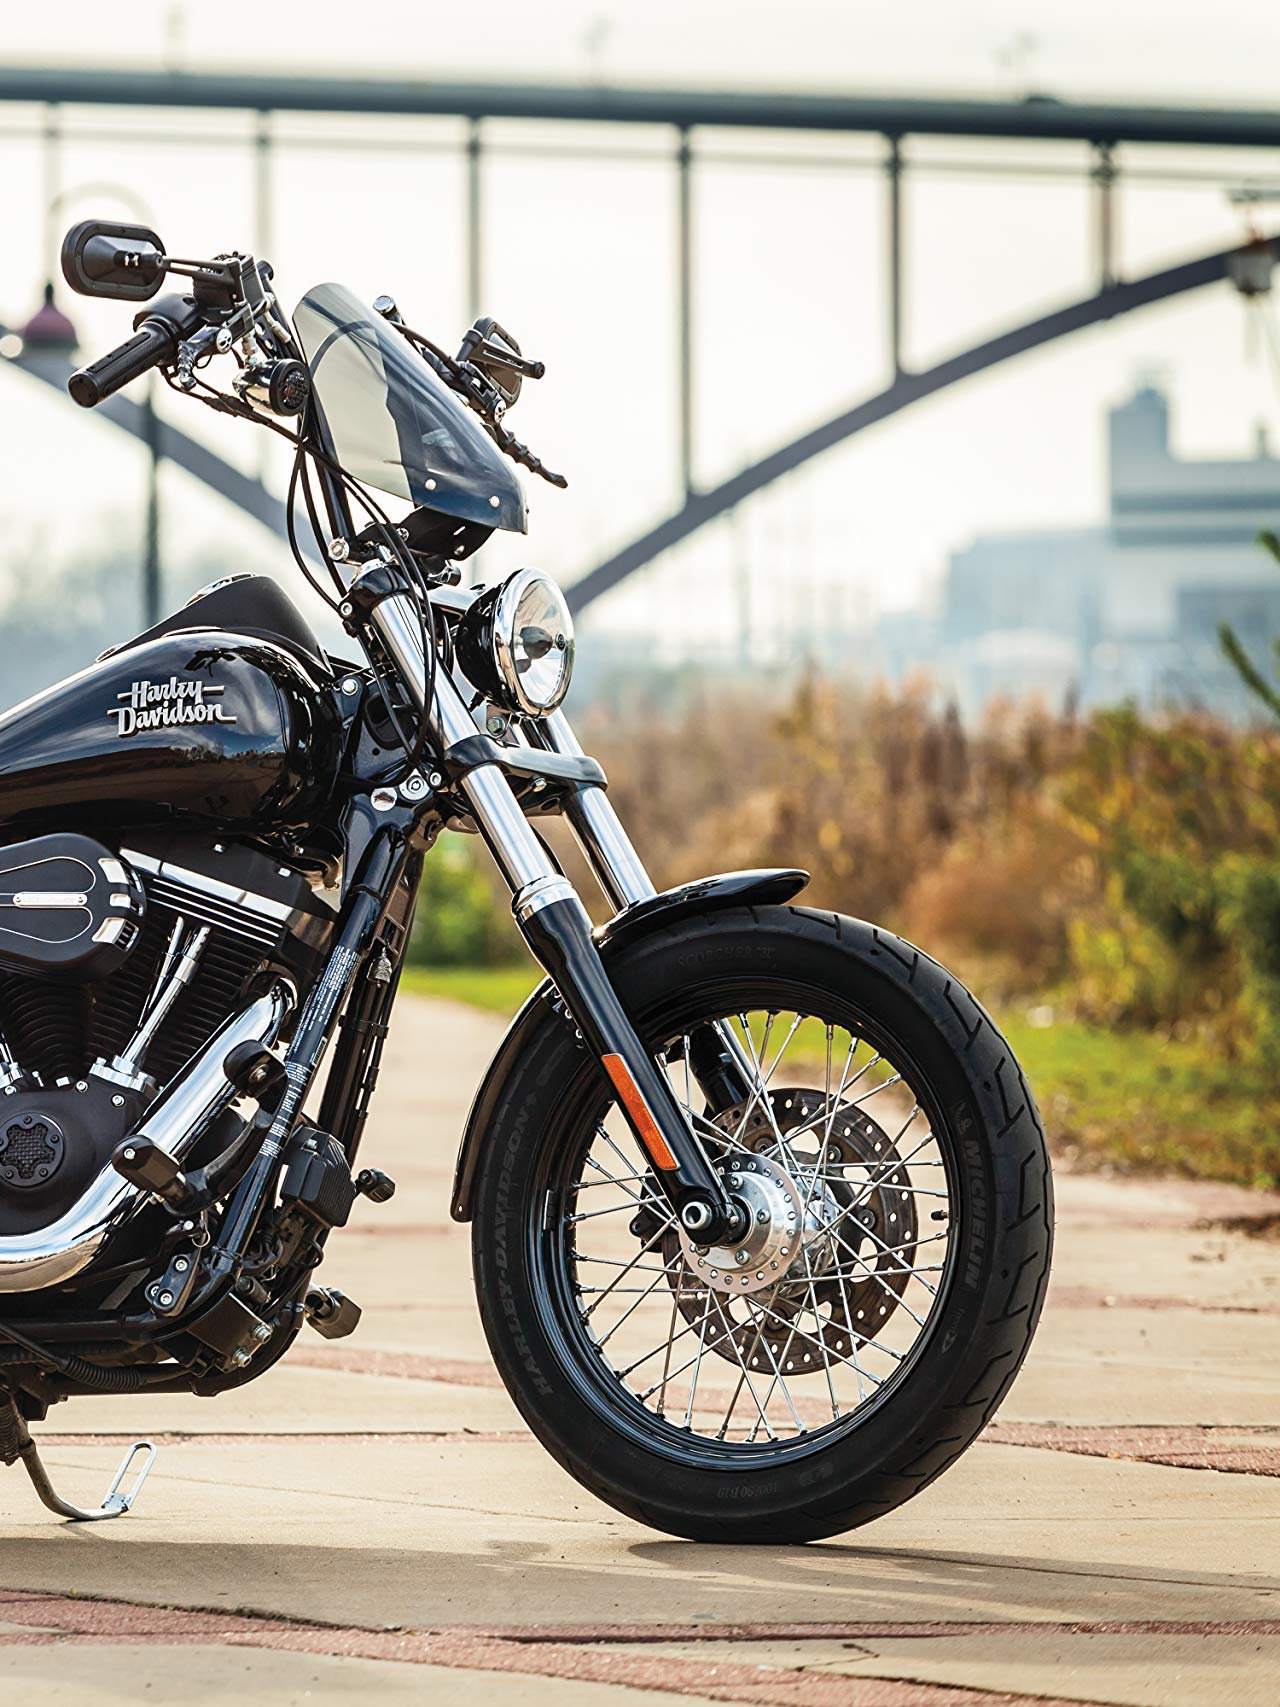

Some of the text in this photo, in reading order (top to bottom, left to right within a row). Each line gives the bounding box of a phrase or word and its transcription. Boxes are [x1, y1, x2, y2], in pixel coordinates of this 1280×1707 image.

[117, 676, 224, 708] Harley
[107, 699, 237, 736] Davidson
[963, 1139, 987, 1291] MICHELIN
